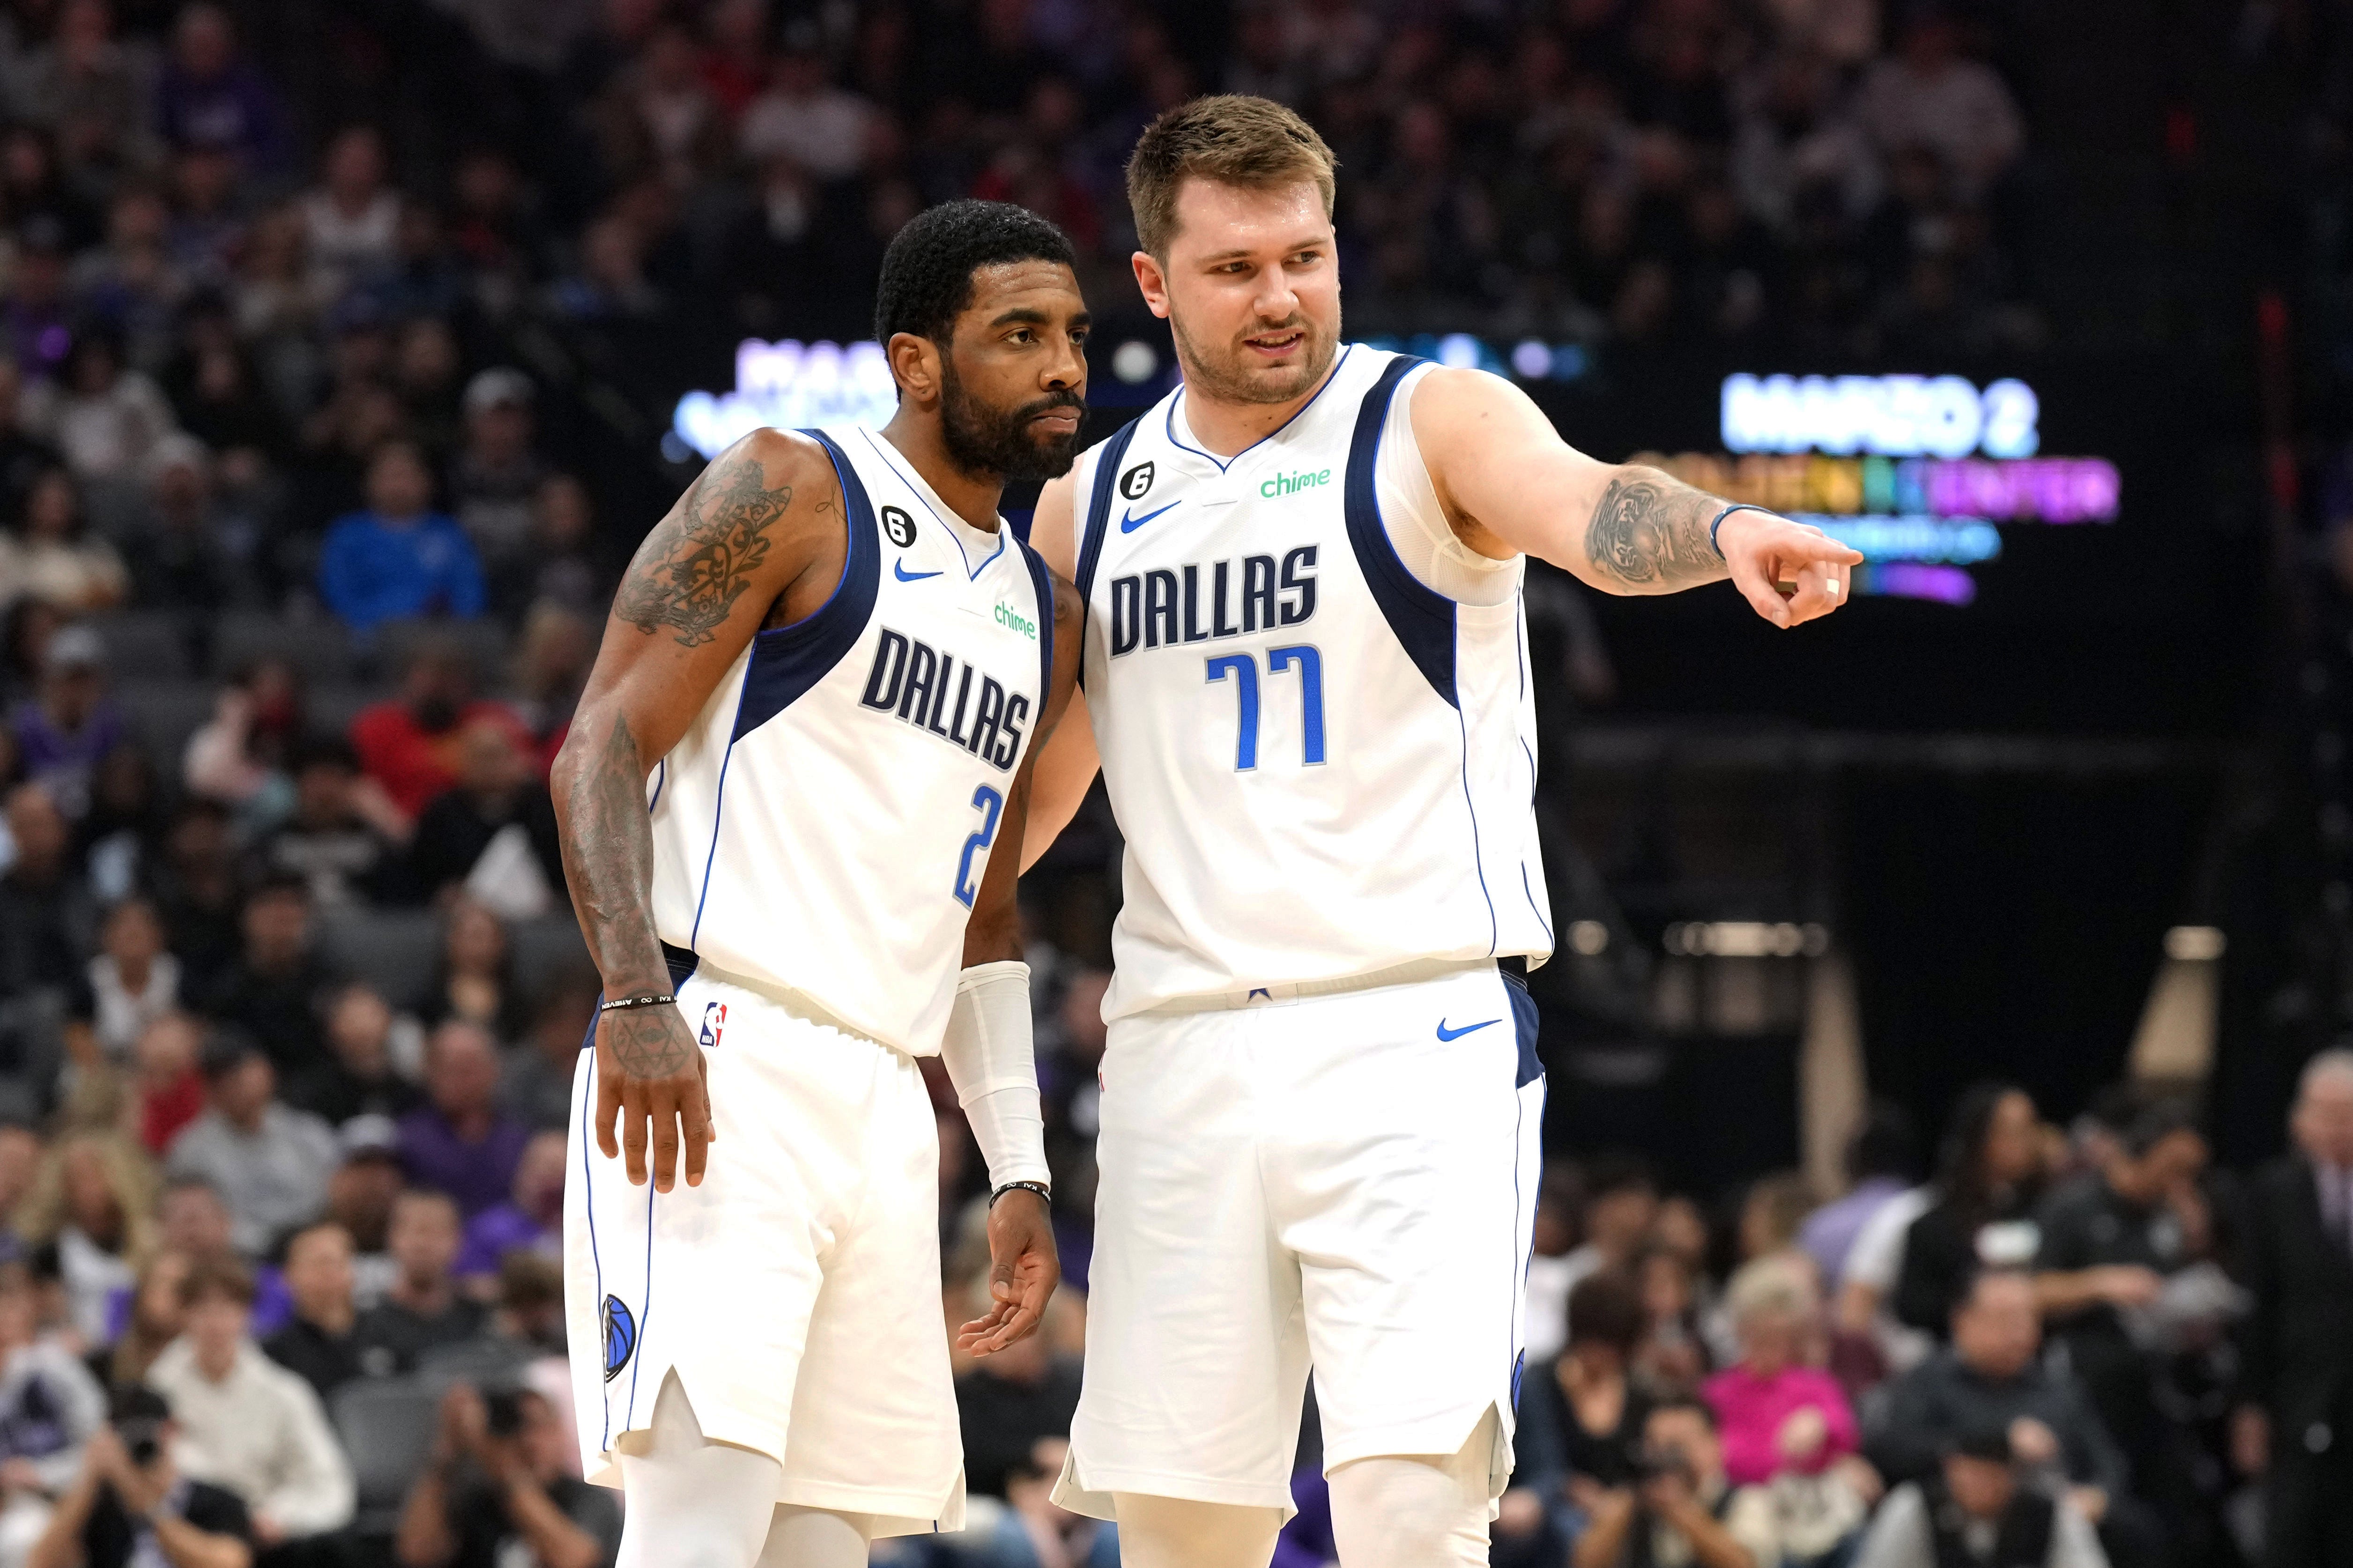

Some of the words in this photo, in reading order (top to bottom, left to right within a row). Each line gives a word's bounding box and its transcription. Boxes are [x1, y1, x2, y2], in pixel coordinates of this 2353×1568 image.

[1129, 466, 1151, 496] 6
[1260, 469, 1330, 498] chime
[886, 511, 907, 543] 6
[995, 601, 1036, 640] chime
[1109, 542, 1320, 660] DALLAS
[858, 624, 1030, 772] DALLAS
[1205, 643, 1327, 772] 77
[952, 782, 1003, 912] 2
[701, 1035, 713, 1044] NBA
